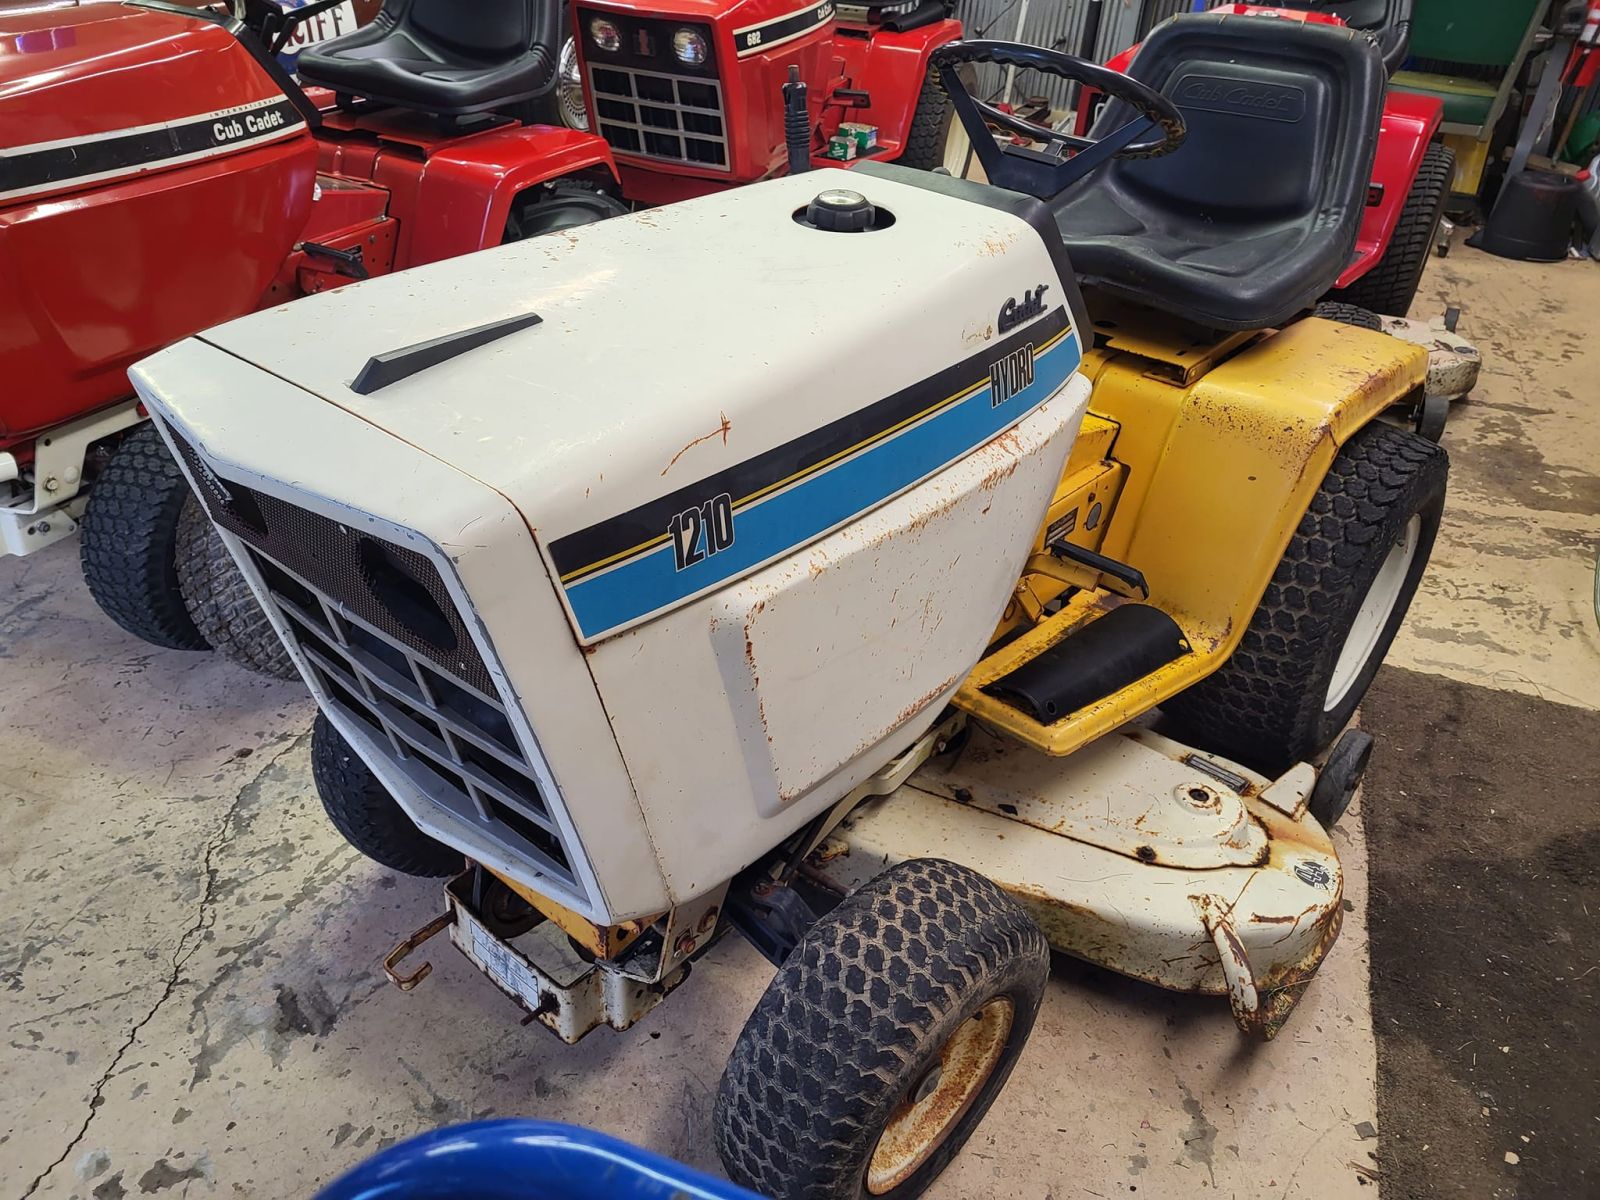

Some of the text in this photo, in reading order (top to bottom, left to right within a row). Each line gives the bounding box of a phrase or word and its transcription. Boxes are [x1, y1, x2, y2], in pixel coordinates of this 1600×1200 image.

[747, 31, 761, 46] 682
[209, 98, 276, 118] INTERNATIONAL
[213, 110, 284, 141] Cub Cadet
[989, 342, 1035, 410] HYDRO
[667, 492, 735, 573] 1210
